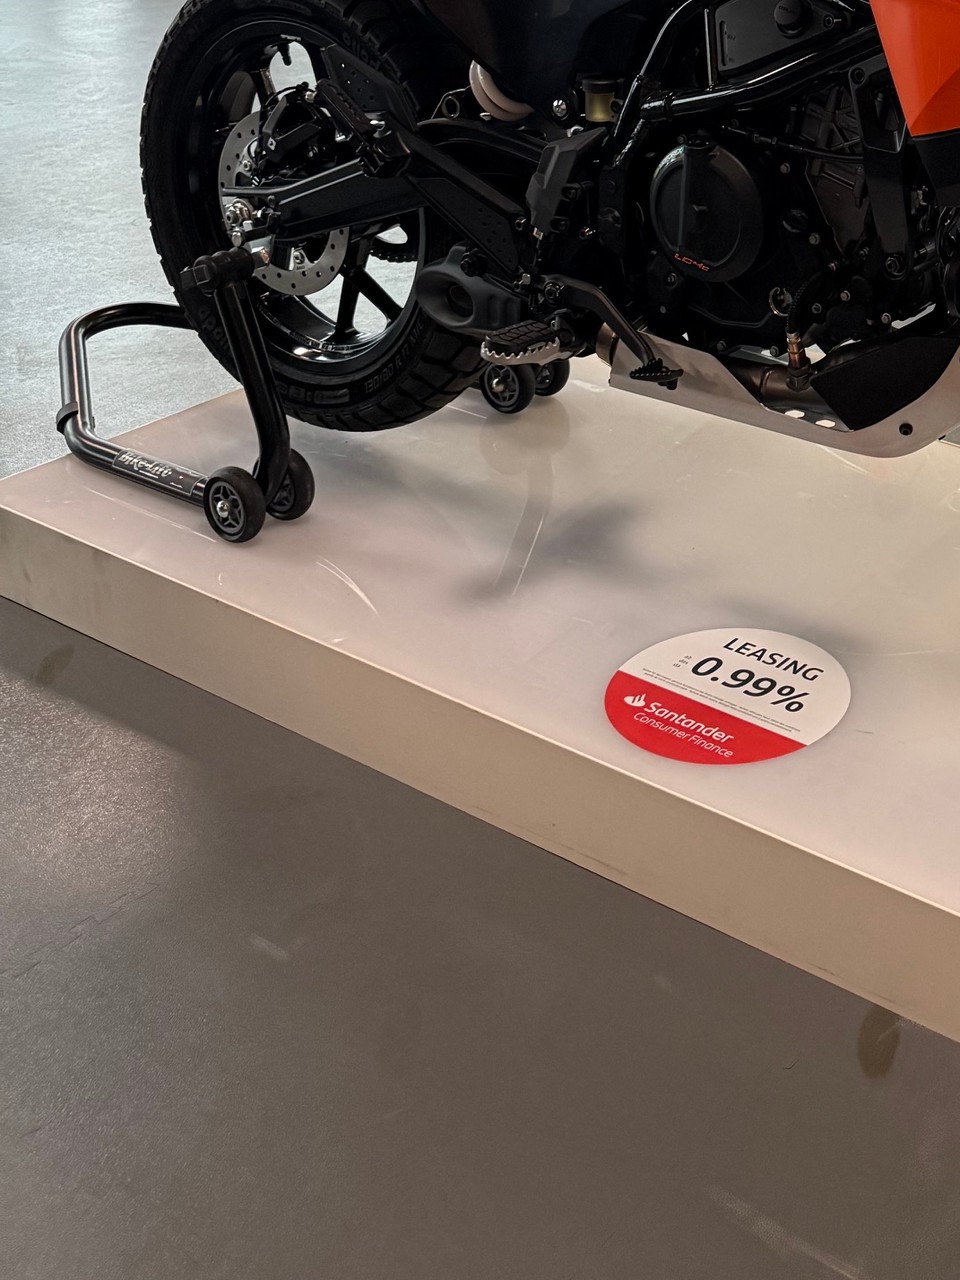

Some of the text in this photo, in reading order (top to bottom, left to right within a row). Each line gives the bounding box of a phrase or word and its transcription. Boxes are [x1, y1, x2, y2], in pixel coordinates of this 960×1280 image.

[723, 637, 824, 682] LEASING
[690, 656, 810, 713] 0.99%
[633, 712, 733, 758] Consumer Finance
[643, 701, 734, 743] Santander
